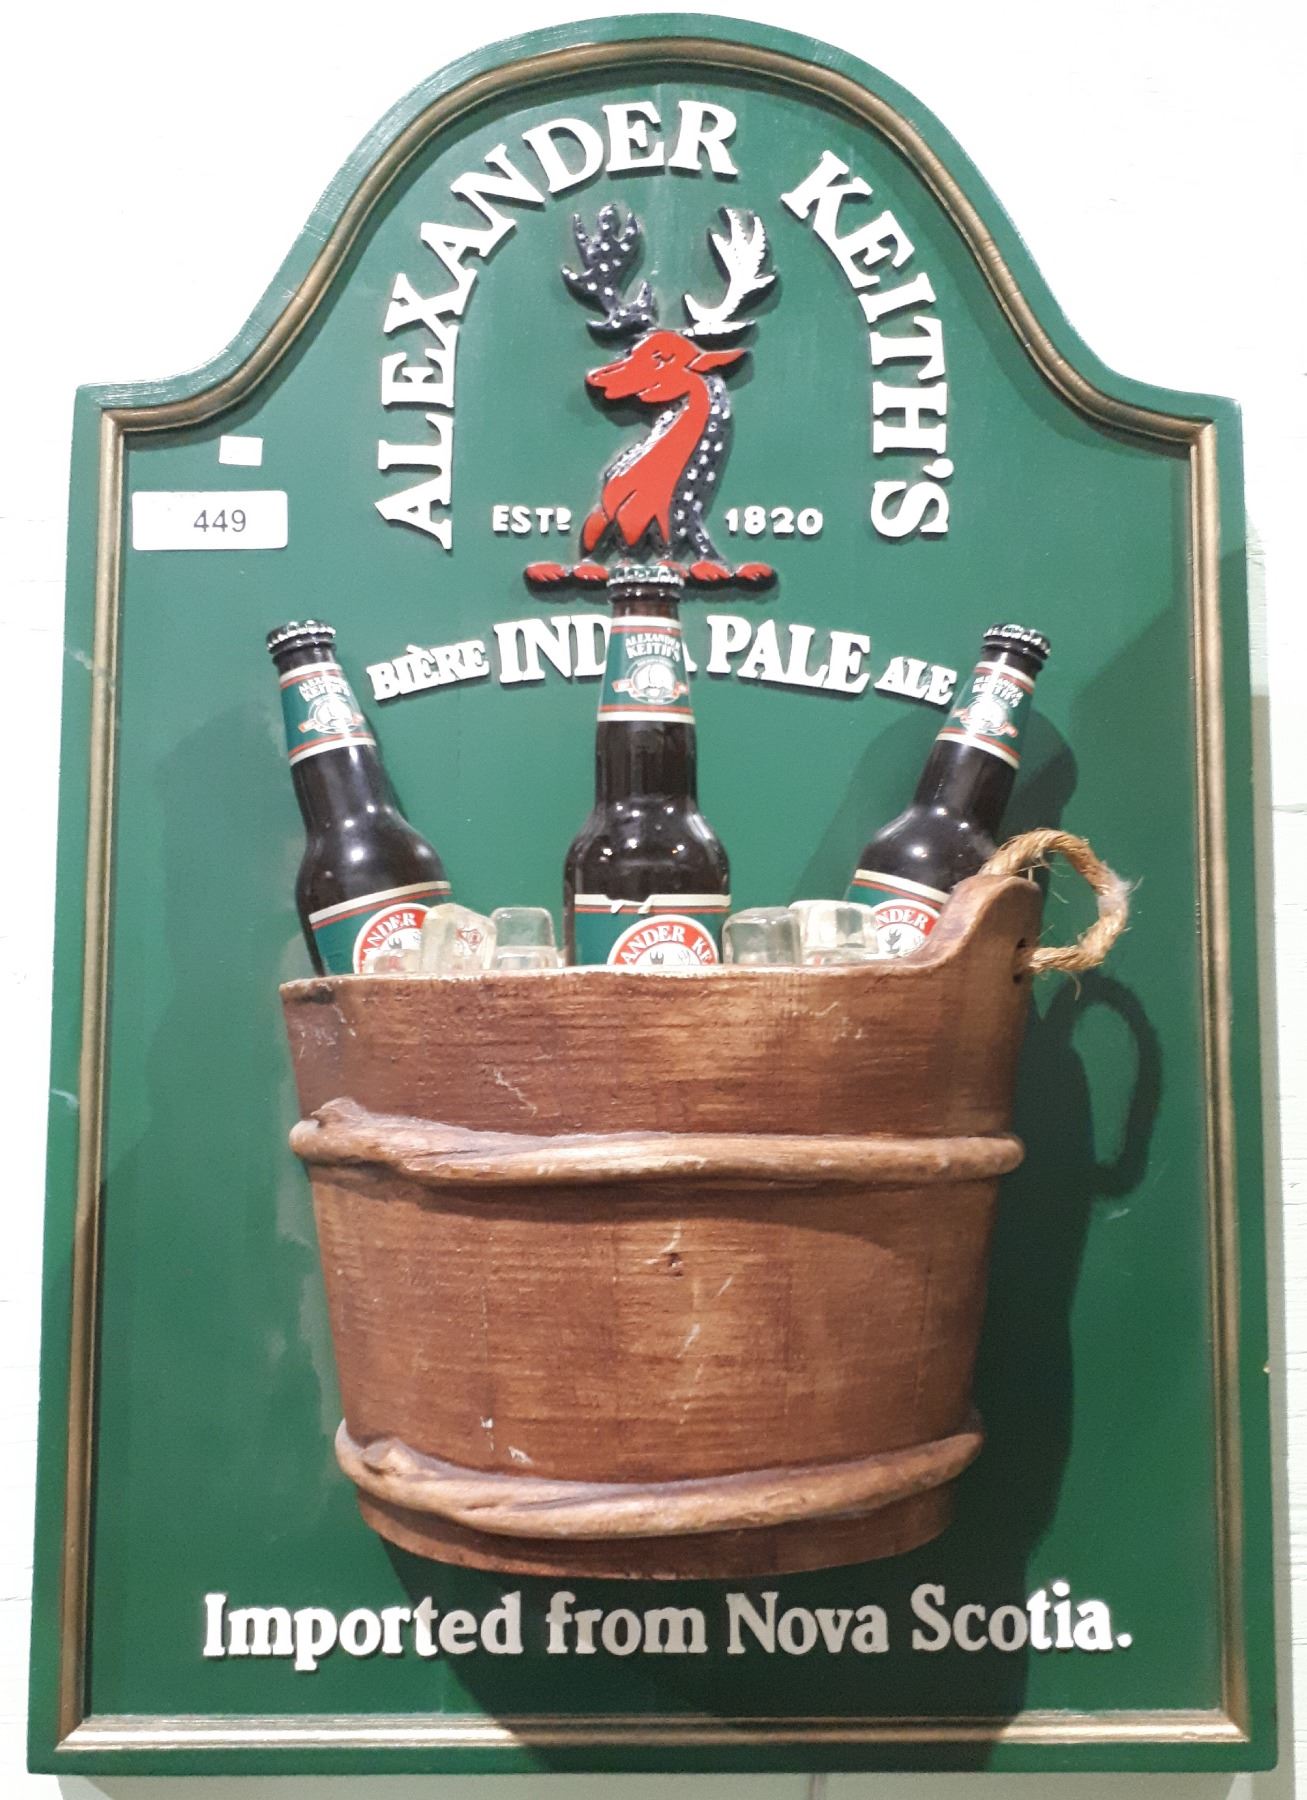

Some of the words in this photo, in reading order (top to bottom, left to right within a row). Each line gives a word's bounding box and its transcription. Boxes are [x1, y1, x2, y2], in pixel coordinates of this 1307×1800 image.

[374, 100, 739, 550] ALEXANDER
[780, 149, 954, 538] KEITH'S
[193, 509, 247, 532] 449
[725, 506, 823, 535] 1820
[366, 640, 490, 701] BIÈRE
[493, 614, 698, 684] IND
[706, 615, 871, 694] PALE
[875, 656, 957, 706] ALE
[621, 925, 686, 964] ANDER
[202, 1591, 523, 1672] Imported
[545, 1589, 709, 1656] from
[727, 1591, 890, 1656] Nova
[911, 1580, 1134, 1653] Scotia.
